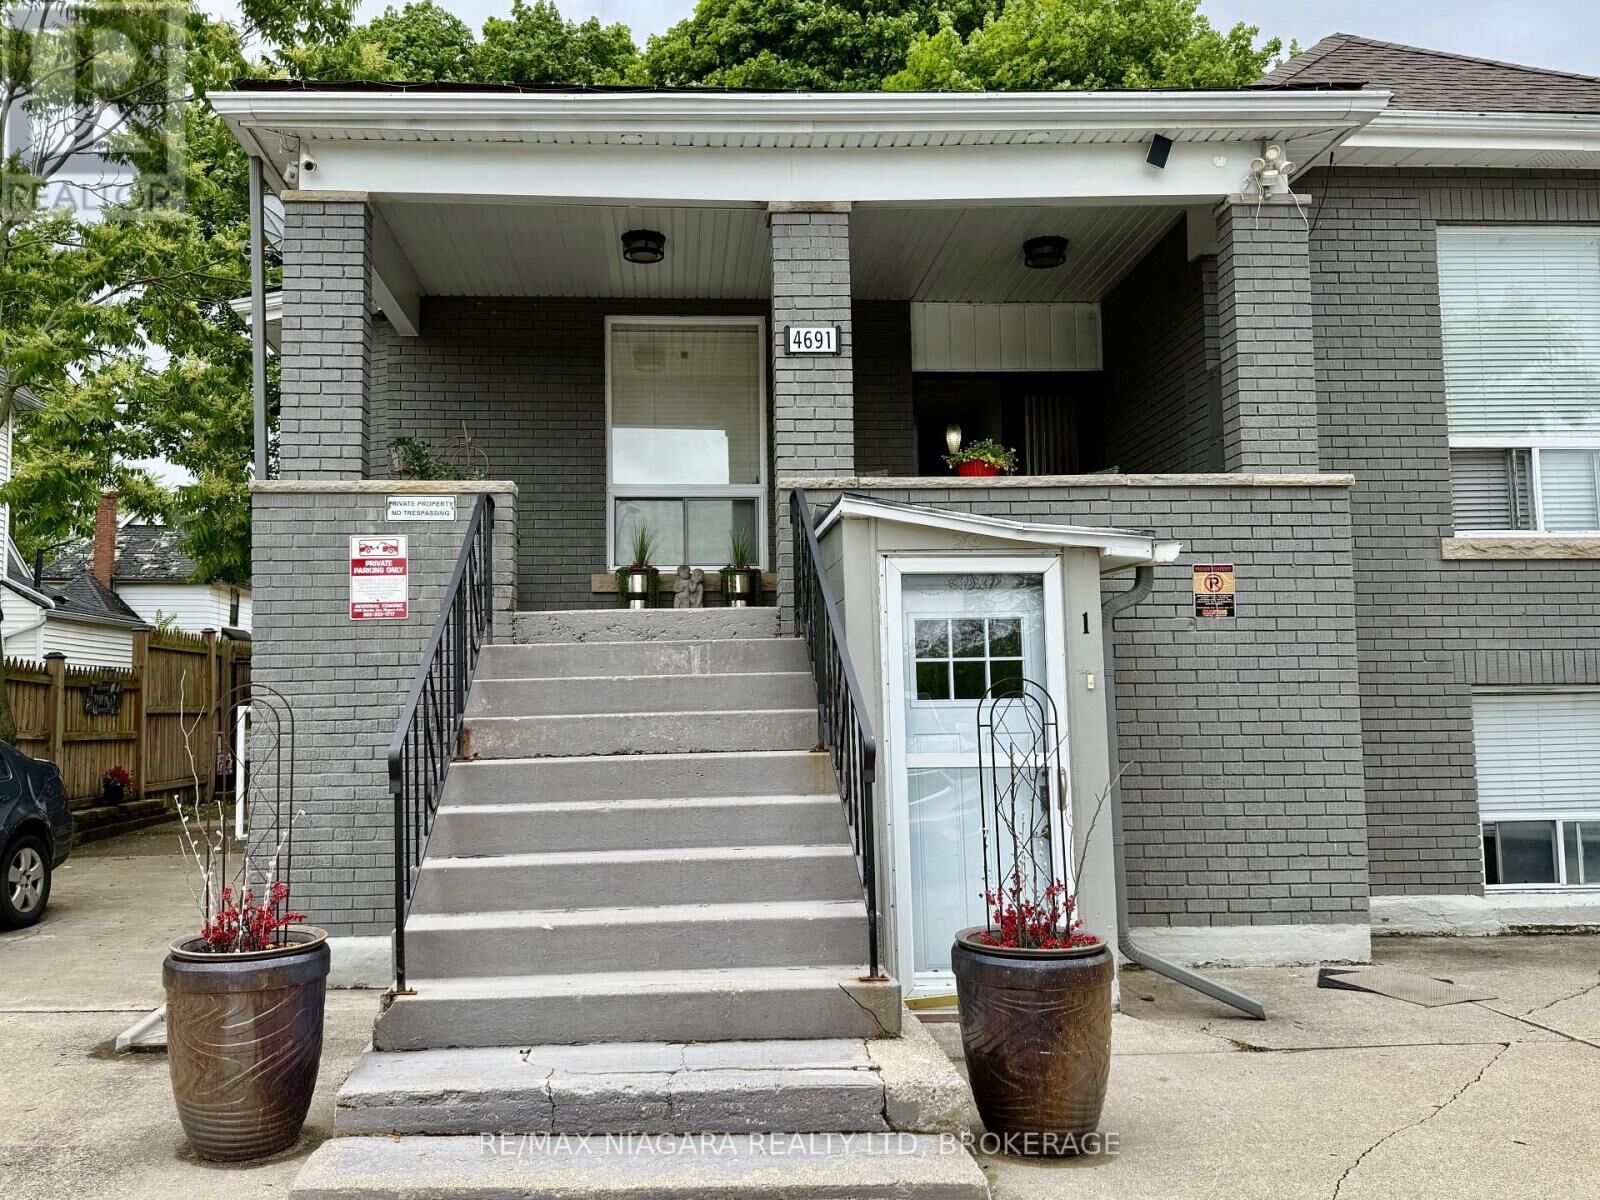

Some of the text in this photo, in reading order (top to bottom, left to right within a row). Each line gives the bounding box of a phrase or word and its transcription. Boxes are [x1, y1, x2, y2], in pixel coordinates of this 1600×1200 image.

[793, 330, 831, 349] 4691
[386, 566, 405, 574] ONLY
[1082, 611, 1090, 635] 1
